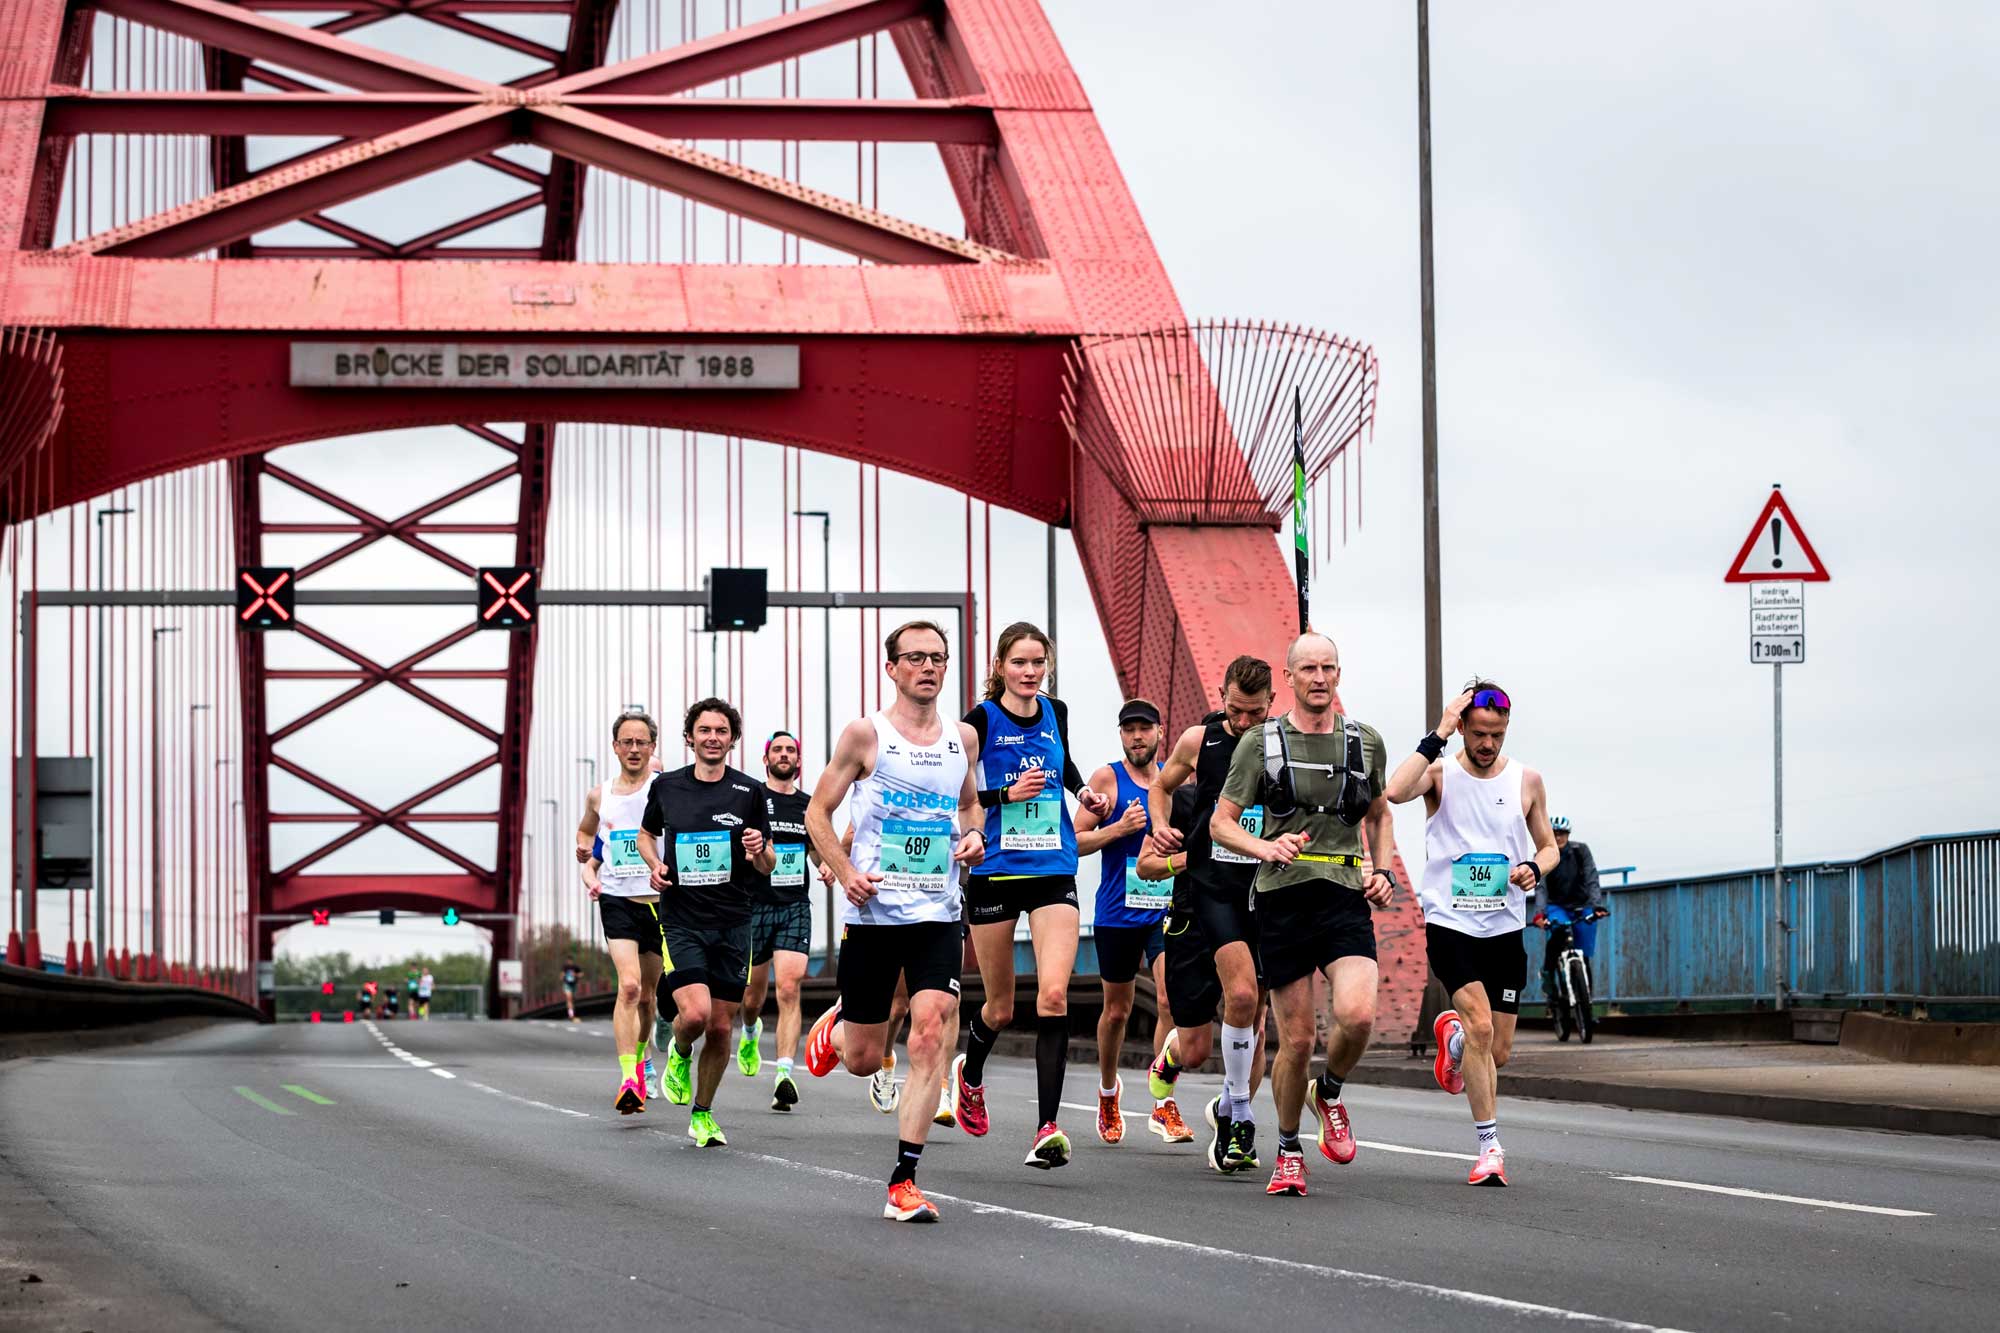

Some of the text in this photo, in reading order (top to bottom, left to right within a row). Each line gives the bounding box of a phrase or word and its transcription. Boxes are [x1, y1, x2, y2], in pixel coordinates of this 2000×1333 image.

[458, 354, 510, 377] DER
[525, 350, 685, 377] SOLIDARITÄT
[697, 355, 754, 377] 1988
[1761, 588, 1789, 596] niedrige
[1755, 613, 1798, 621] Radfahrer
[1757, 623, 1799, 632] absteigen
[1764, 644, 1791, 657] 300m
[1020, 755, 1045, 769] ASV
[1005, 769, 1057, 782] DURG
[1026, 802, 1038, 819] F1
[696, 843, 710, 858] 88
[905, 836, 930, 856] 689
[782, 853, 795, 864] 600
[1469, 866, 1491, 881] 364
[883, 880, 910, 889] Duisburg
[981, 904, 1003, 913] bunert
